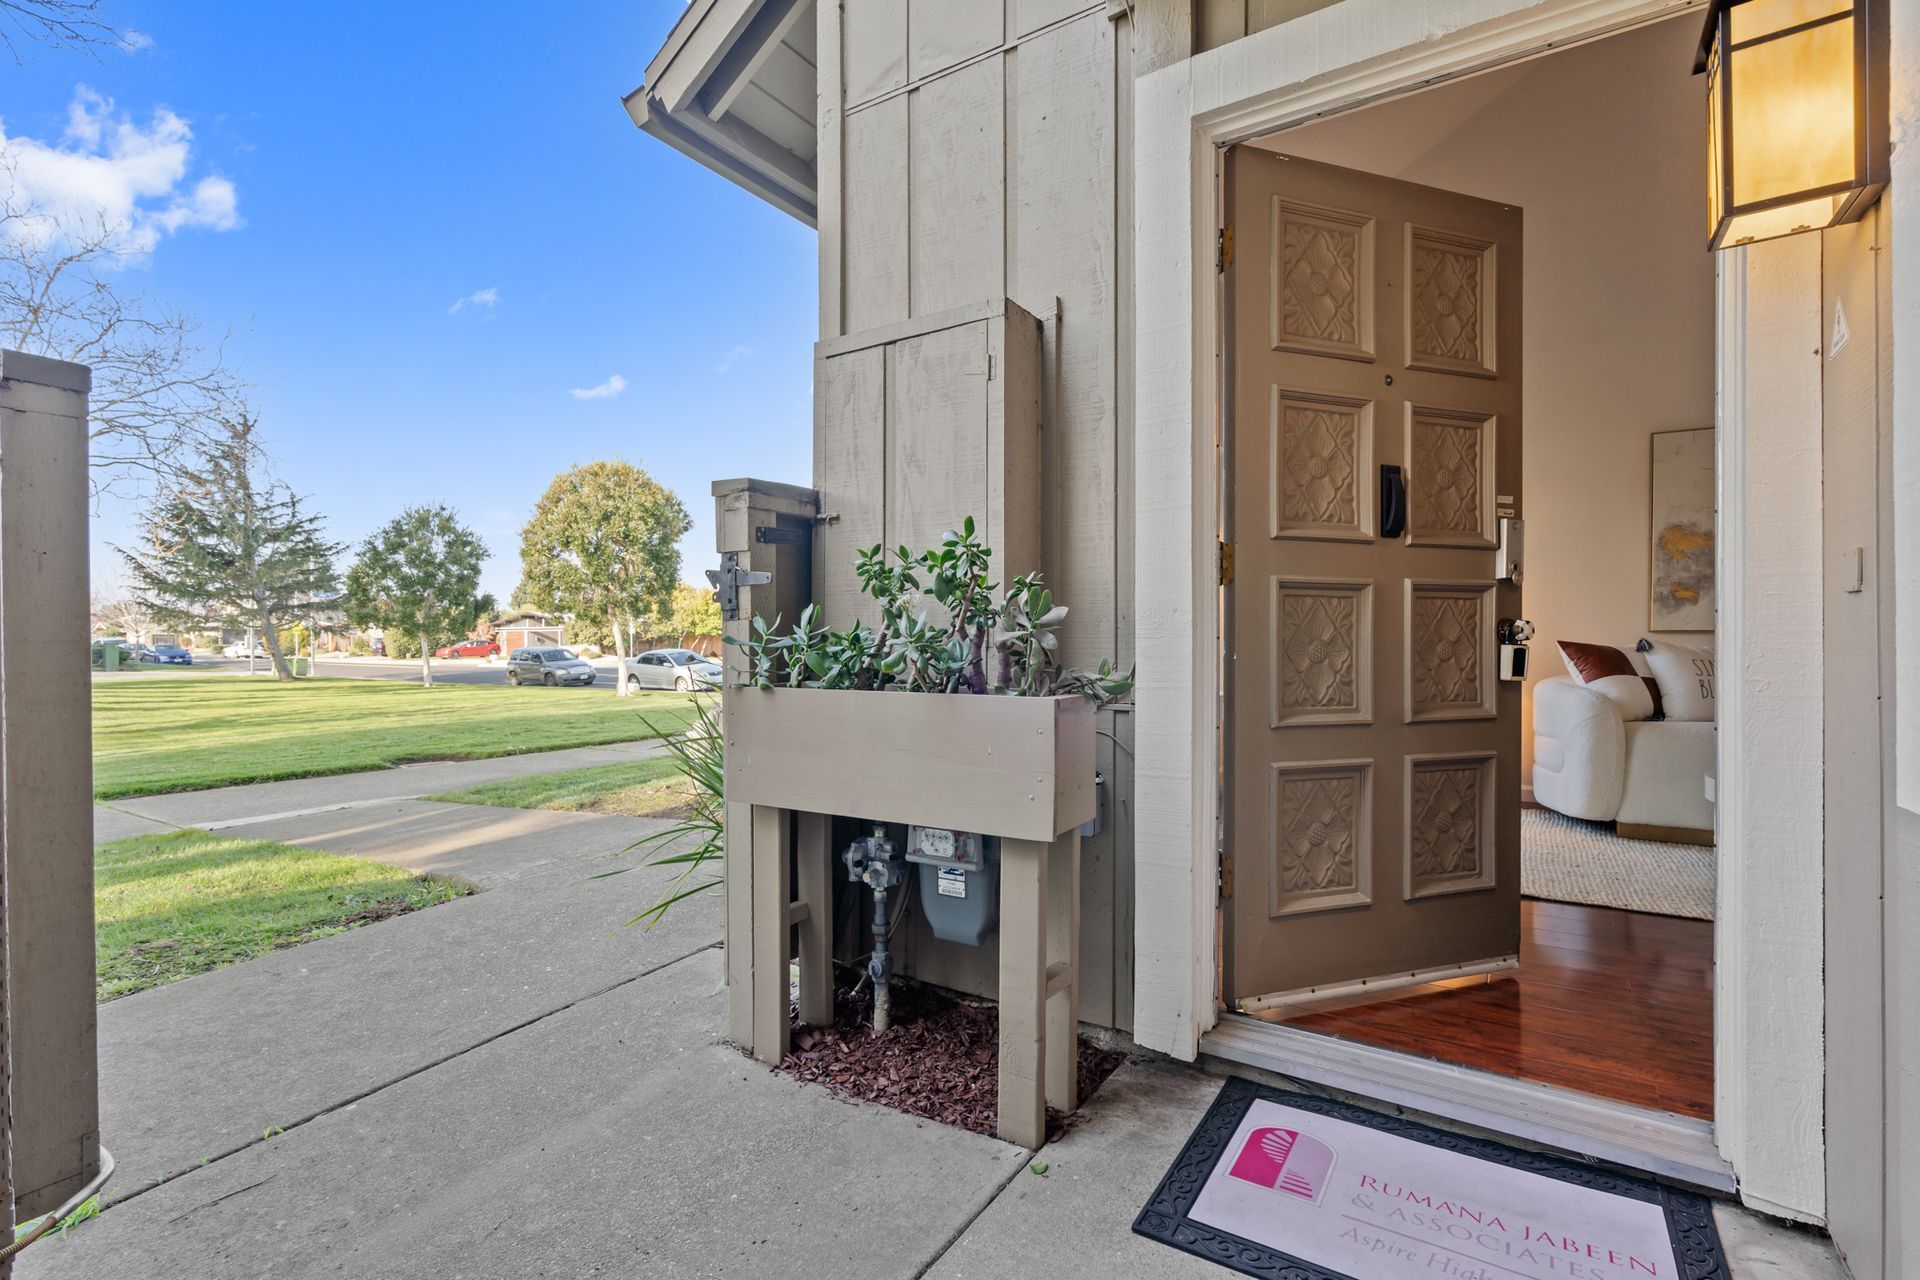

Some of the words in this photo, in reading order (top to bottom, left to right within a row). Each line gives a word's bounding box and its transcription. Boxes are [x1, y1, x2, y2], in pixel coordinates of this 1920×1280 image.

[1339, 1227, 1418, 1262] Aspire
[1351, 1192, 1376, 1212] &
[1388, 1207, 1605, 1280] ASSOCIATES
[1360, 1174, 1508, 1232] RUMANA
[1523, 1225, 1658, 1276] JABEEN
